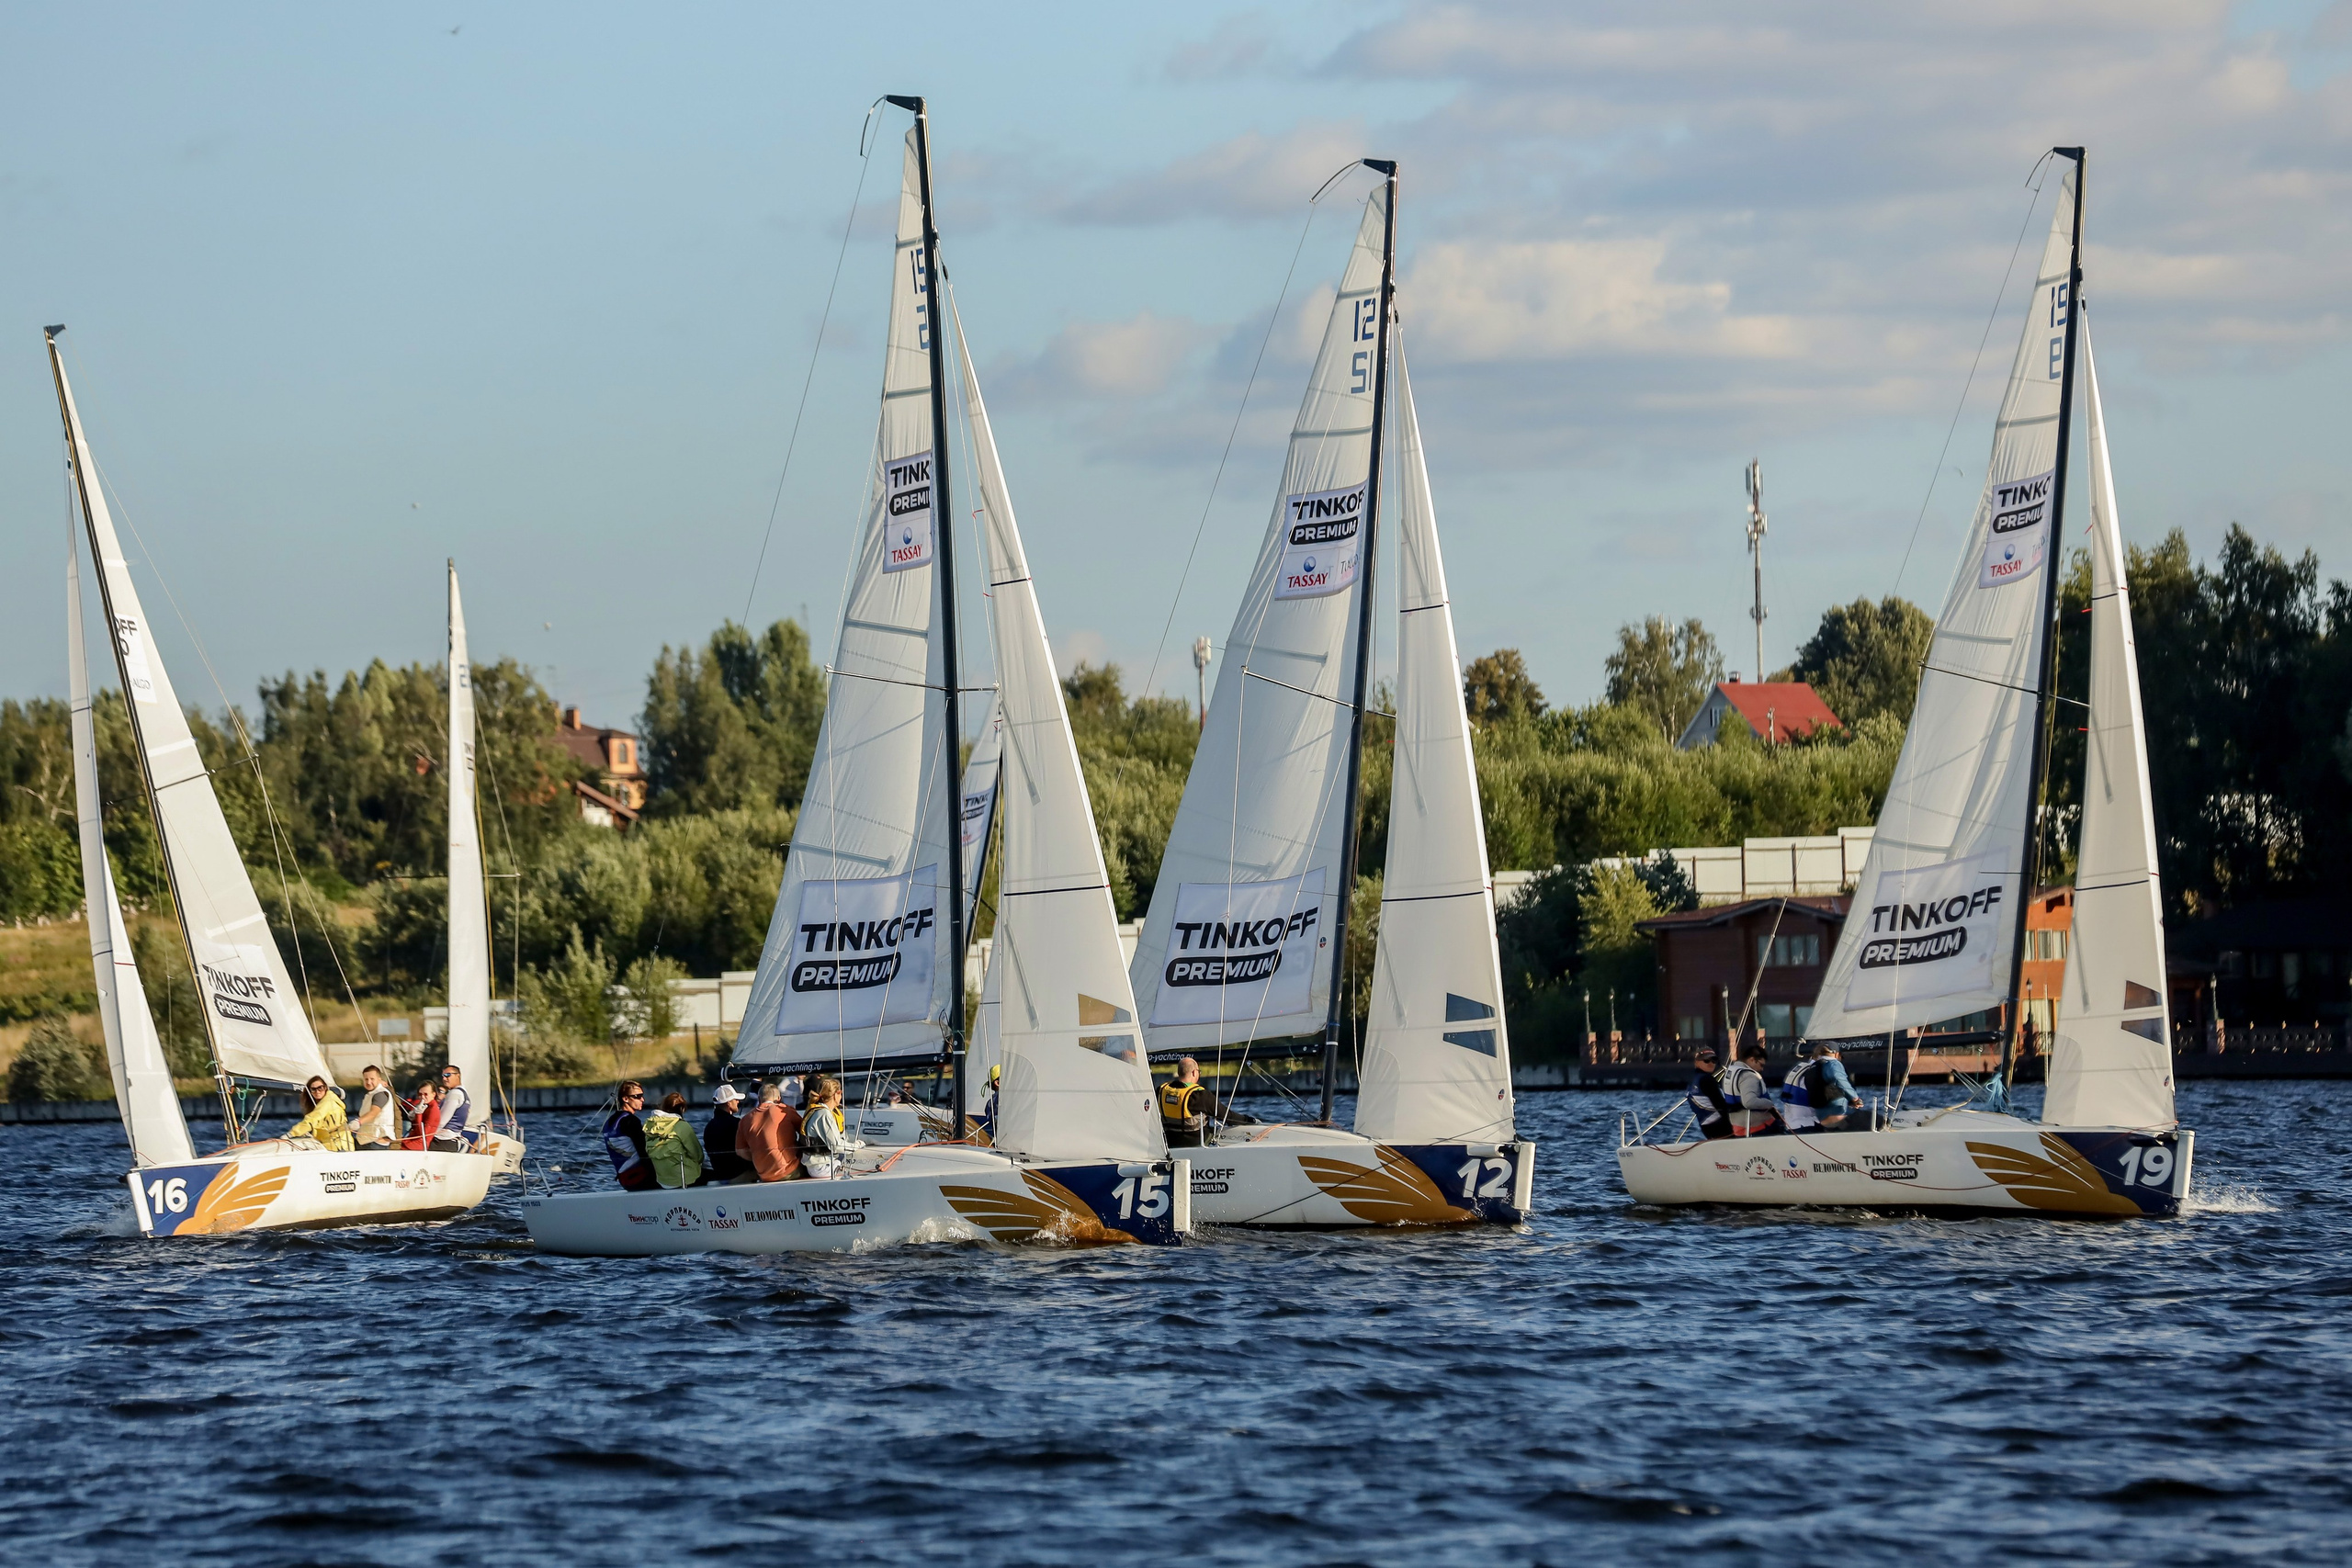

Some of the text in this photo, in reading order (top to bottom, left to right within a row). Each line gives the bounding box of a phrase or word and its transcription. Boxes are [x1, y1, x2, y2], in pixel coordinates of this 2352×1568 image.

[2051, 282, 2068, 328] 19
[1353, 298, 1376, 342] 12
[890, 460, 930, 488] TINK
[893, 490, 930, 513] PREMI
[1997, 474, 2052, 507] TINKO
[1996, 505, 2044, 529] PREMIU
[1294, 519, 1357, 542] PREMIUM
[891, 544, 922, 563] TASSAY
[1990, 558, 2023, 577] TASSAY
[1287, 572, 1329, 588] TASSAY
[1872, 886, 2002, 932] TINKOFF
[800, 908, 933, 953] TINKOFF
[1175, 907, 1319, 949] TINKOFF
[1864, 932, 1962, 964] PREMIUM
[797, 958, 898, 987] PREMIUM
[1171, 955, 1275, 981] PREMIUM
[201, 964, 276, 998] TINKOFF
[215, 998, 270, 1022] PREMIUM
[1861, 1154, 1924, 1167] TINKOFF
[2118, 1146, 2174, 1186] 19
[320, 1170, 360, 1181] TINKOFF
[1191, 1168, 1235, 1180] KOFF
[1456, 1157, 1513, 1198] 12
[1781, 1169, 1807, 1179] TASSAY
[1873, 1169, 1916, 1179] PREMIUM
[147, 1177, 188, 1214] 16
[1111, 1175, 1170, 1220] 15
[1191, 1183, 1227, 1192] REMIUM
[744, 1209, 796, 1223] ВЕДОМОСТИ
[800, 1197, 871, 1213] TINKOFF
[708, 1219, 739, 1229] TASSAY
[814, 1213, 863, 1224] PREMIUM
